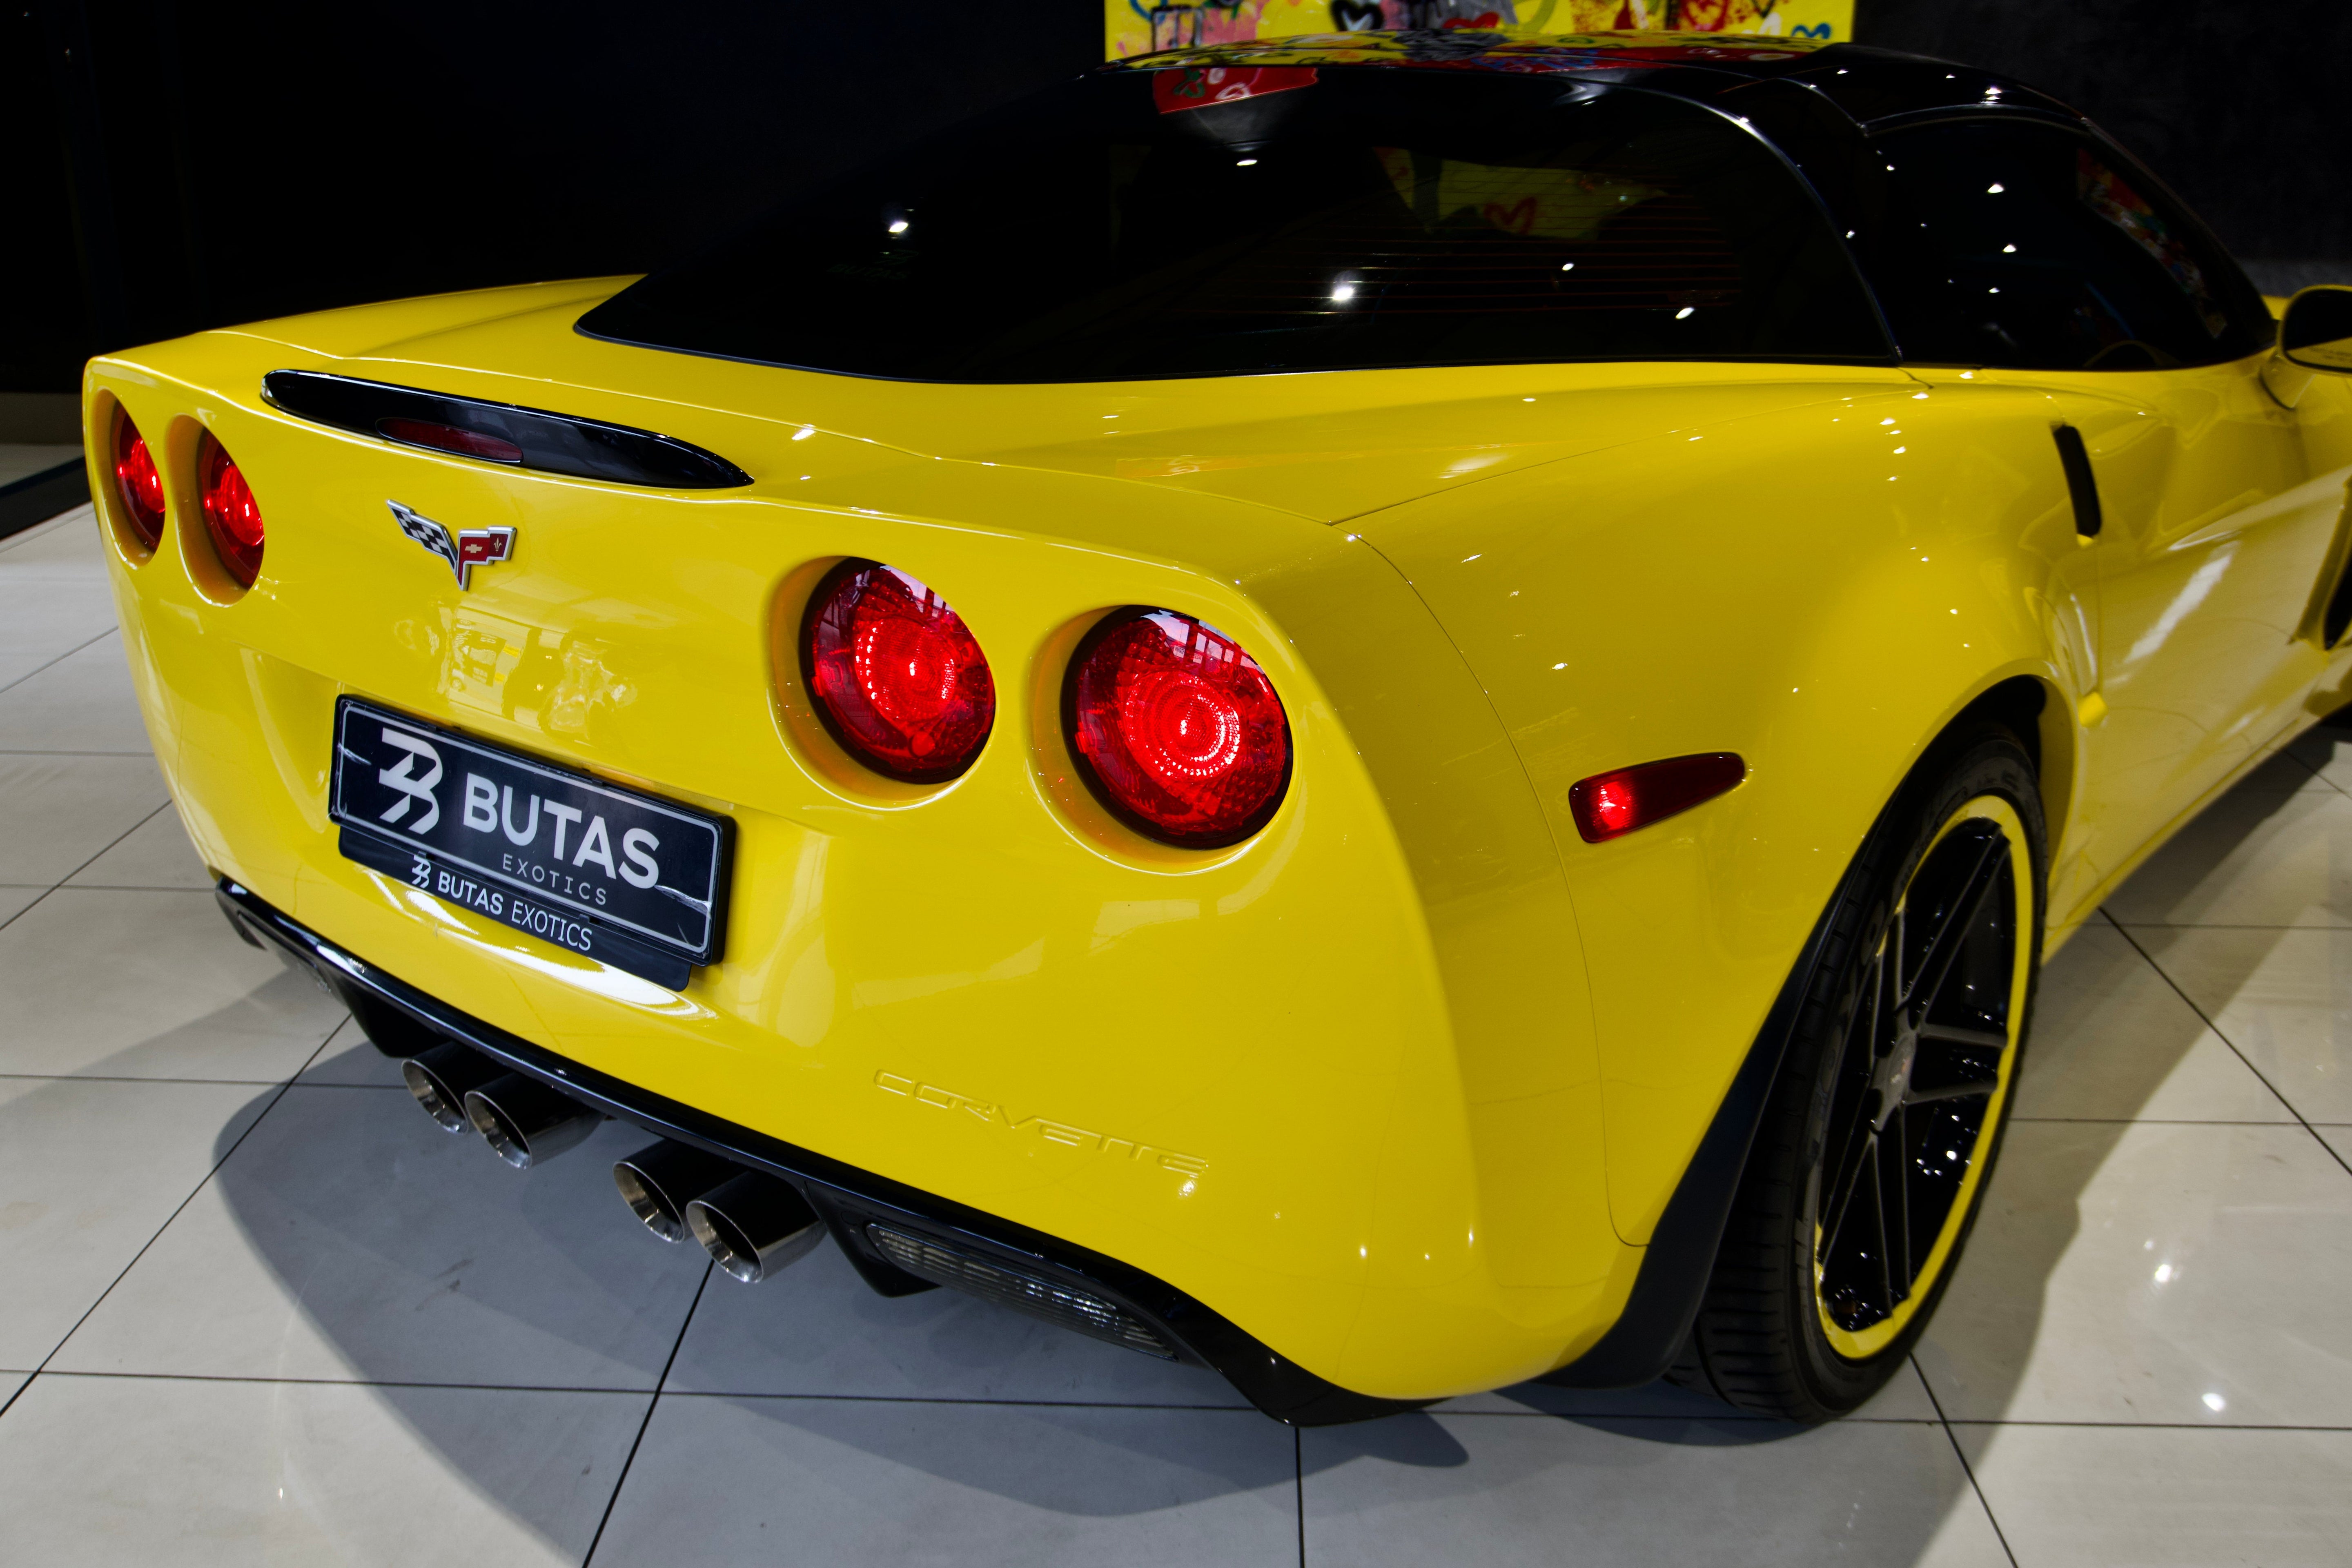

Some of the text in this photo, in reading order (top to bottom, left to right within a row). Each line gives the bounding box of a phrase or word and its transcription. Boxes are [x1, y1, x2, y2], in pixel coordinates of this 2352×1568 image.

[463, 773, 660, 889] BUTAS
[438, 871, 503, 915] BUTAS
[512, 900, 593, 951] EXOTICS
[503, 854, 607, 905] EXOTICS
[875, 1069, 1209, 1178] CORVETTE
